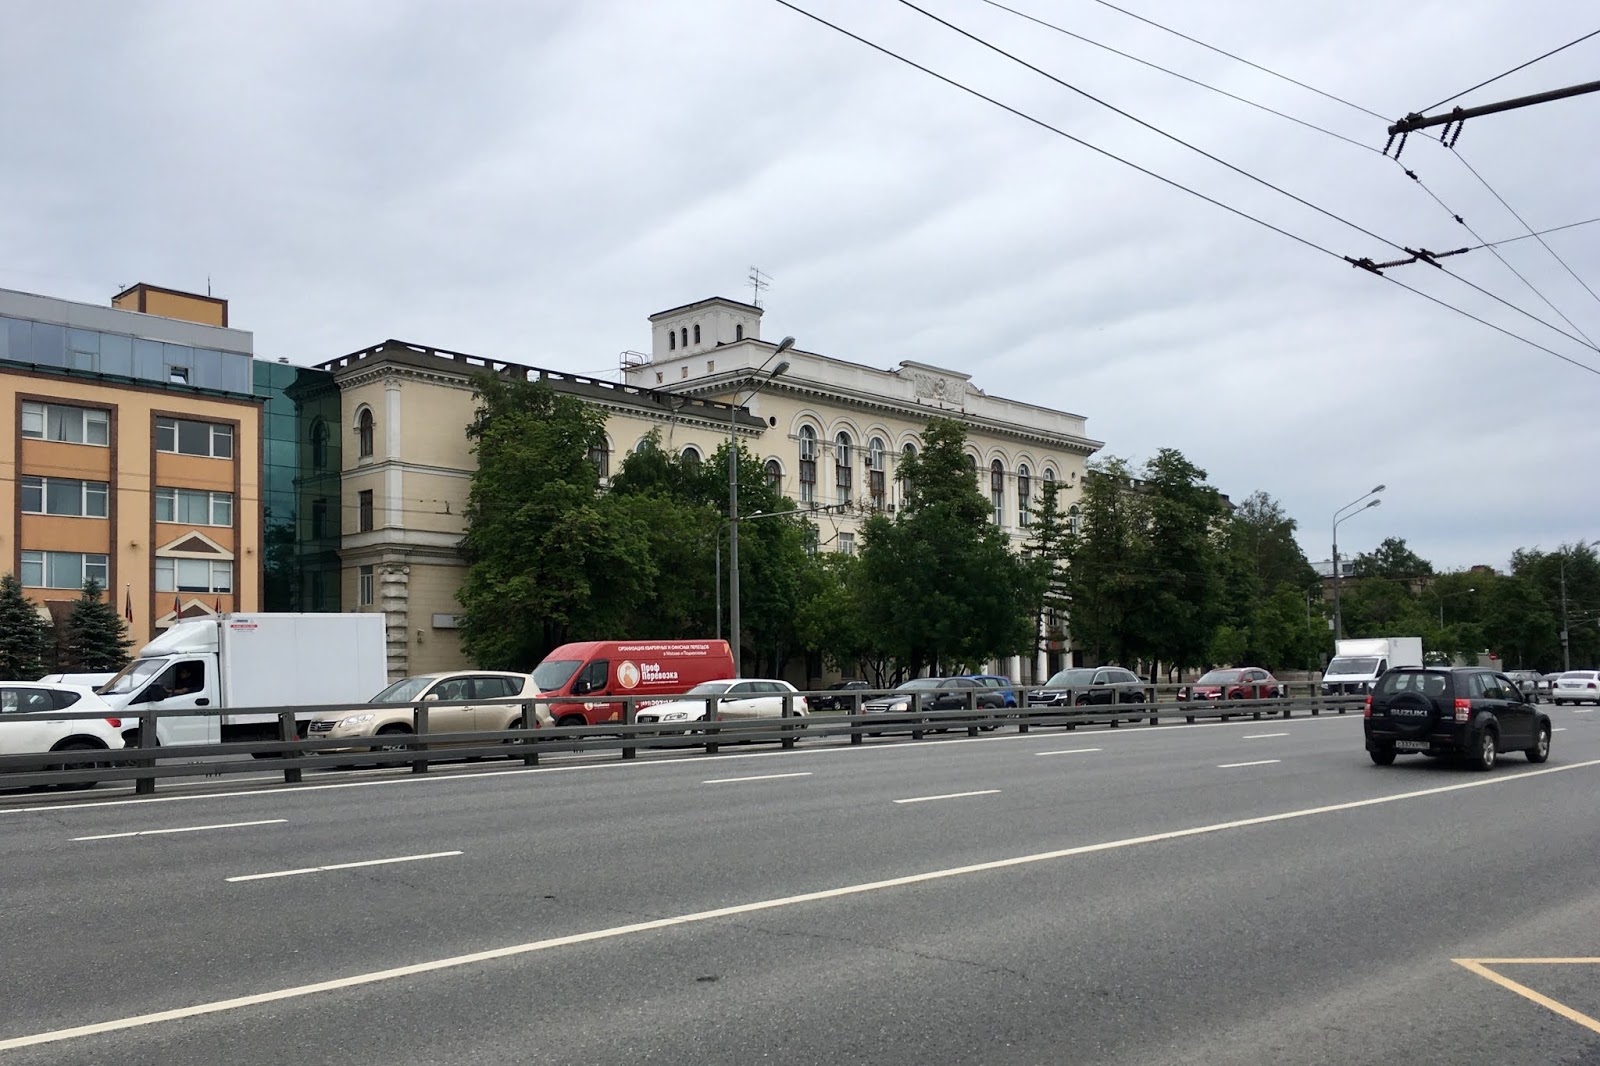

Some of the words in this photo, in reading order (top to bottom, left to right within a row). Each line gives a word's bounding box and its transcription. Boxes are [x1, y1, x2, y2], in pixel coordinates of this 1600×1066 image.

[641, 663, 660, 673] Проф
[642, 671, 678, 681] Перевозка
[1390, 708, 1428, 717] SUZUKI
